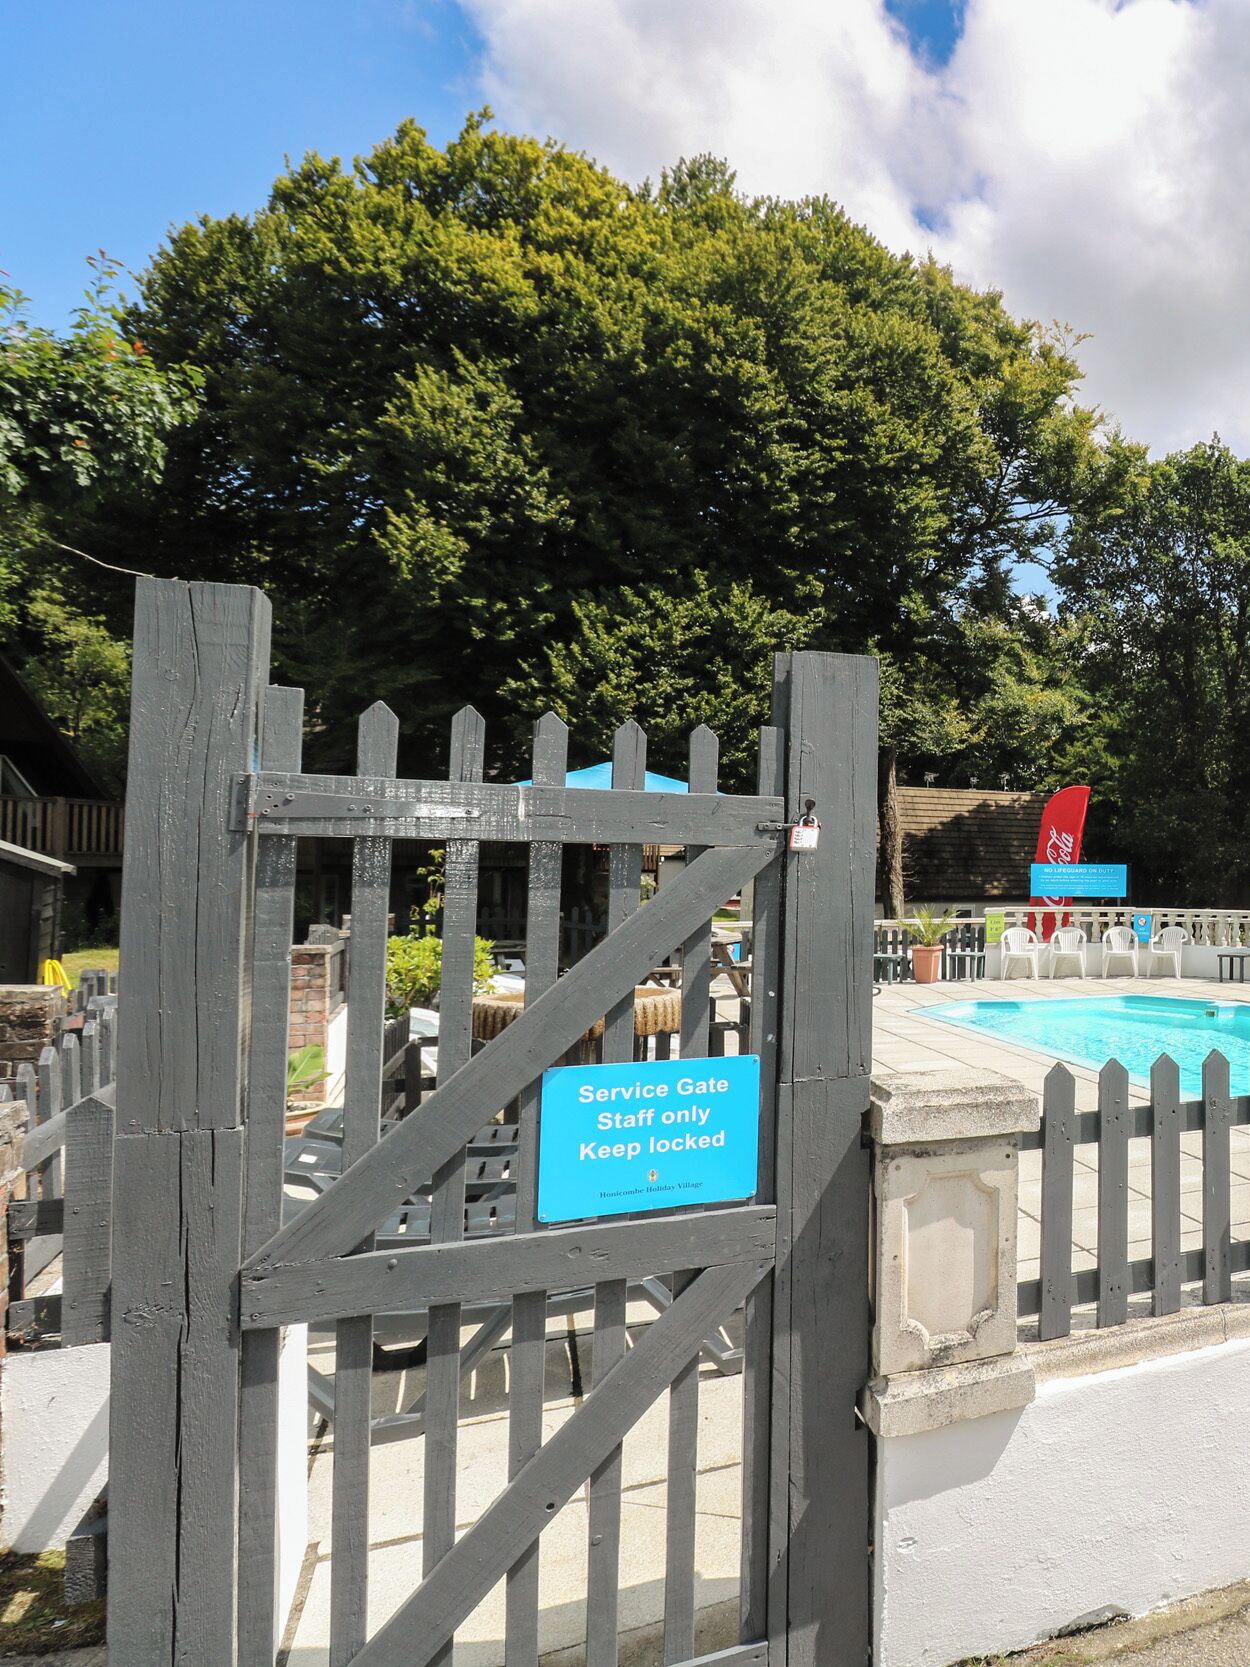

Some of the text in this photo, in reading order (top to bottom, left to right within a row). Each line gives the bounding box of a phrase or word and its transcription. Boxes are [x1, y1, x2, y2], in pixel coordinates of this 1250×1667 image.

[578, 1077, 729, 1103] Service Gate
[597, 1105, 711, 1130] Staff only
[579, 1130, 726, 1161] Keep locked
[599, 1181, 704, 1199] Honicombe Holiday Village
